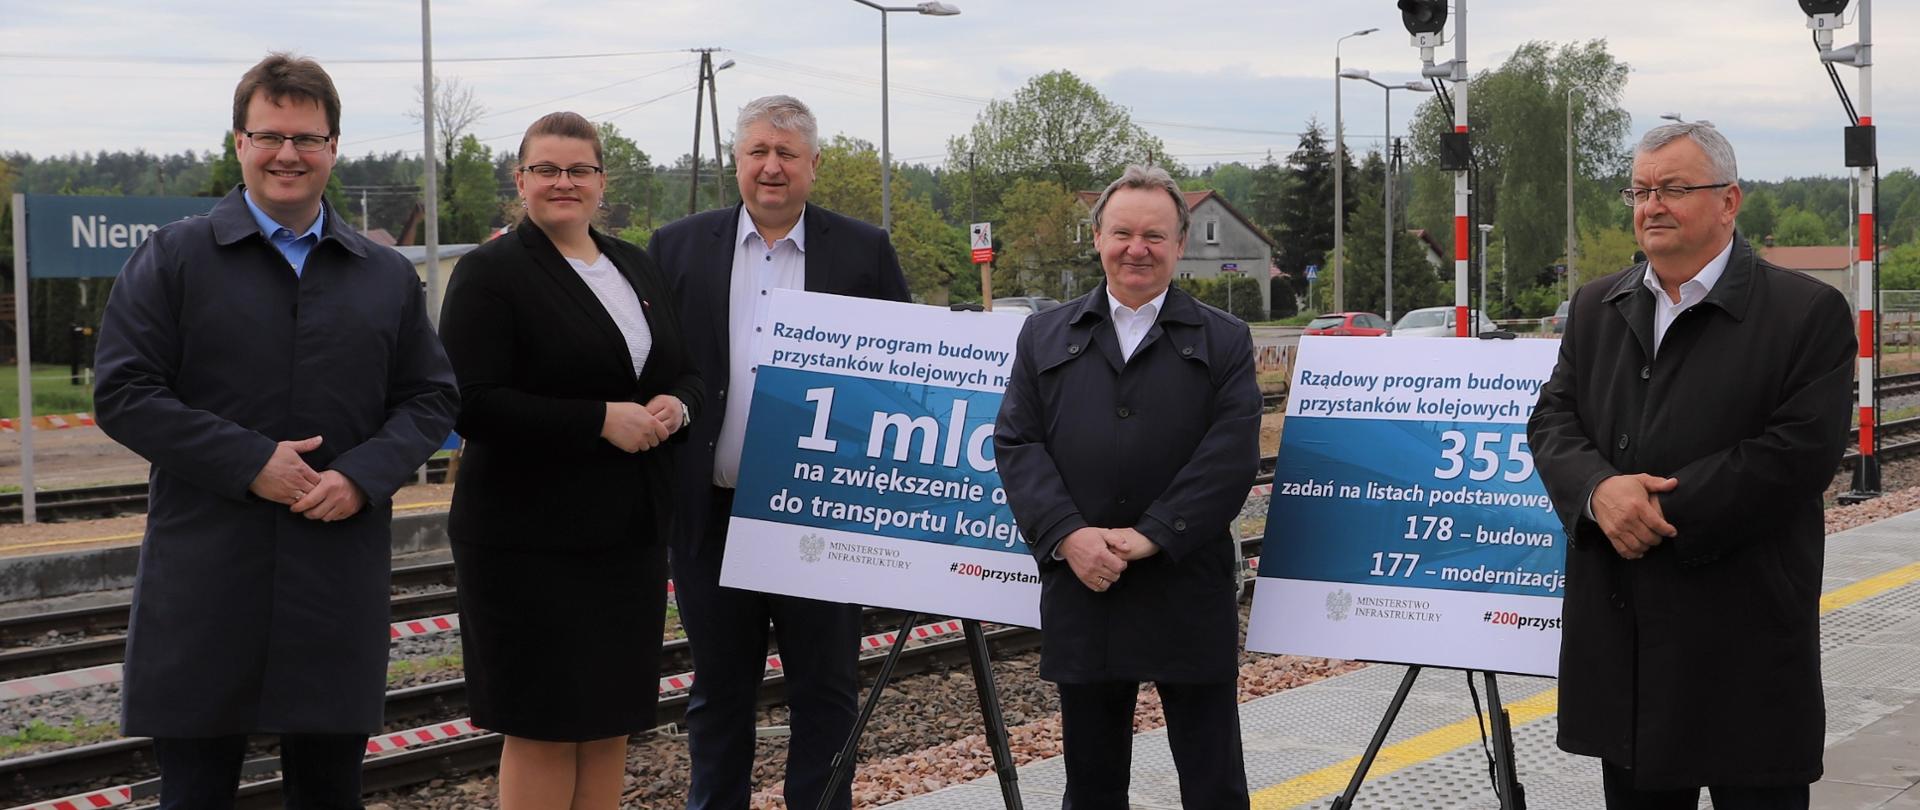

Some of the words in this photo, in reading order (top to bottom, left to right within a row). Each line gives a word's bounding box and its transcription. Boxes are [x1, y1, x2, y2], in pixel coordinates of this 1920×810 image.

[71, 215, 159, 249] Niem
[772, 321, 852, 349] Rządowy
[855, 334, 933, 355] program
[937, 340, 1010, 367] budowy
[771, 349, 884, 374] przystanków
[888, 359, 988, 387] kolejowych
[1299, 370, 1379, 392] Rządowy
[1382, 373, 1462, 393] program
[1467, 372, 1543, 396] budowy
[797, 386, 837, 453] 1
[1298, 396, 1412, 416] przystanków
[1416, 397, 1520, 420] kolejowych
[1433, 430, 1535, 484] 355
[793, 462, 825, 482] na
[831, 465, 984, 502] zwiększenie
[1281, 479, 1335, 498] zadań
[1338, 484, 1361, 499] na
[1365, 481, 1425, 502] listach
[1427, 485, 1554, 513] podstawowej
[769, 489, 804, 514] do
[811, 495, 948, 533] transportu
[954, 511, 1026, 548] kolej
[1403, 515, 1455, 542] 178
[1475, 525, 1554, 547] budowa
[827, 551, 913, 570] INFRASTRUKTURY
[829, 541, 901, 558] MINISTERSTWO
[1369, 551, 1420, 578] 177
[1440, 565, 1566, 593] modernizacja
[1354, 607, 1443, 623] INFRASTRUKTURY
[1356, 596, 1431, 611] MINISTERSTWO
[1483, 610, 1564, 631] #200przyst
